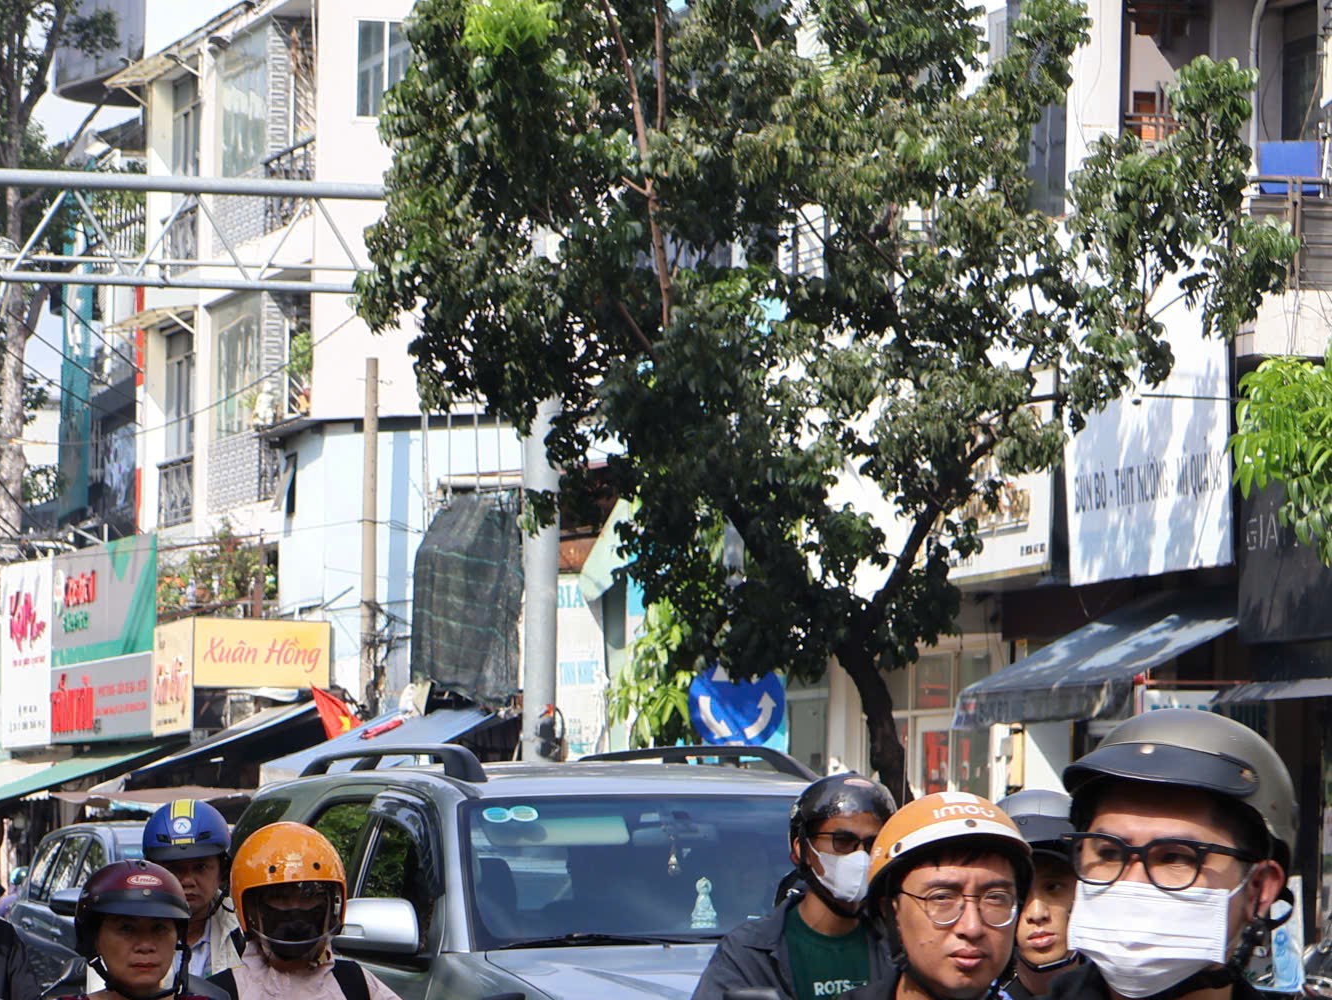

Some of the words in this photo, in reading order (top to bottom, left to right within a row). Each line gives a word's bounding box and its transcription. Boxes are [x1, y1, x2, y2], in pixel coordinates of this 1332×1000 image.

[1094, 461, 1107, 509] BÒ
[1114, 467, 1134, 515] THỊT
[204, 637, 257, 664] Xuân
[264, 637, 322, 673] Hồng
